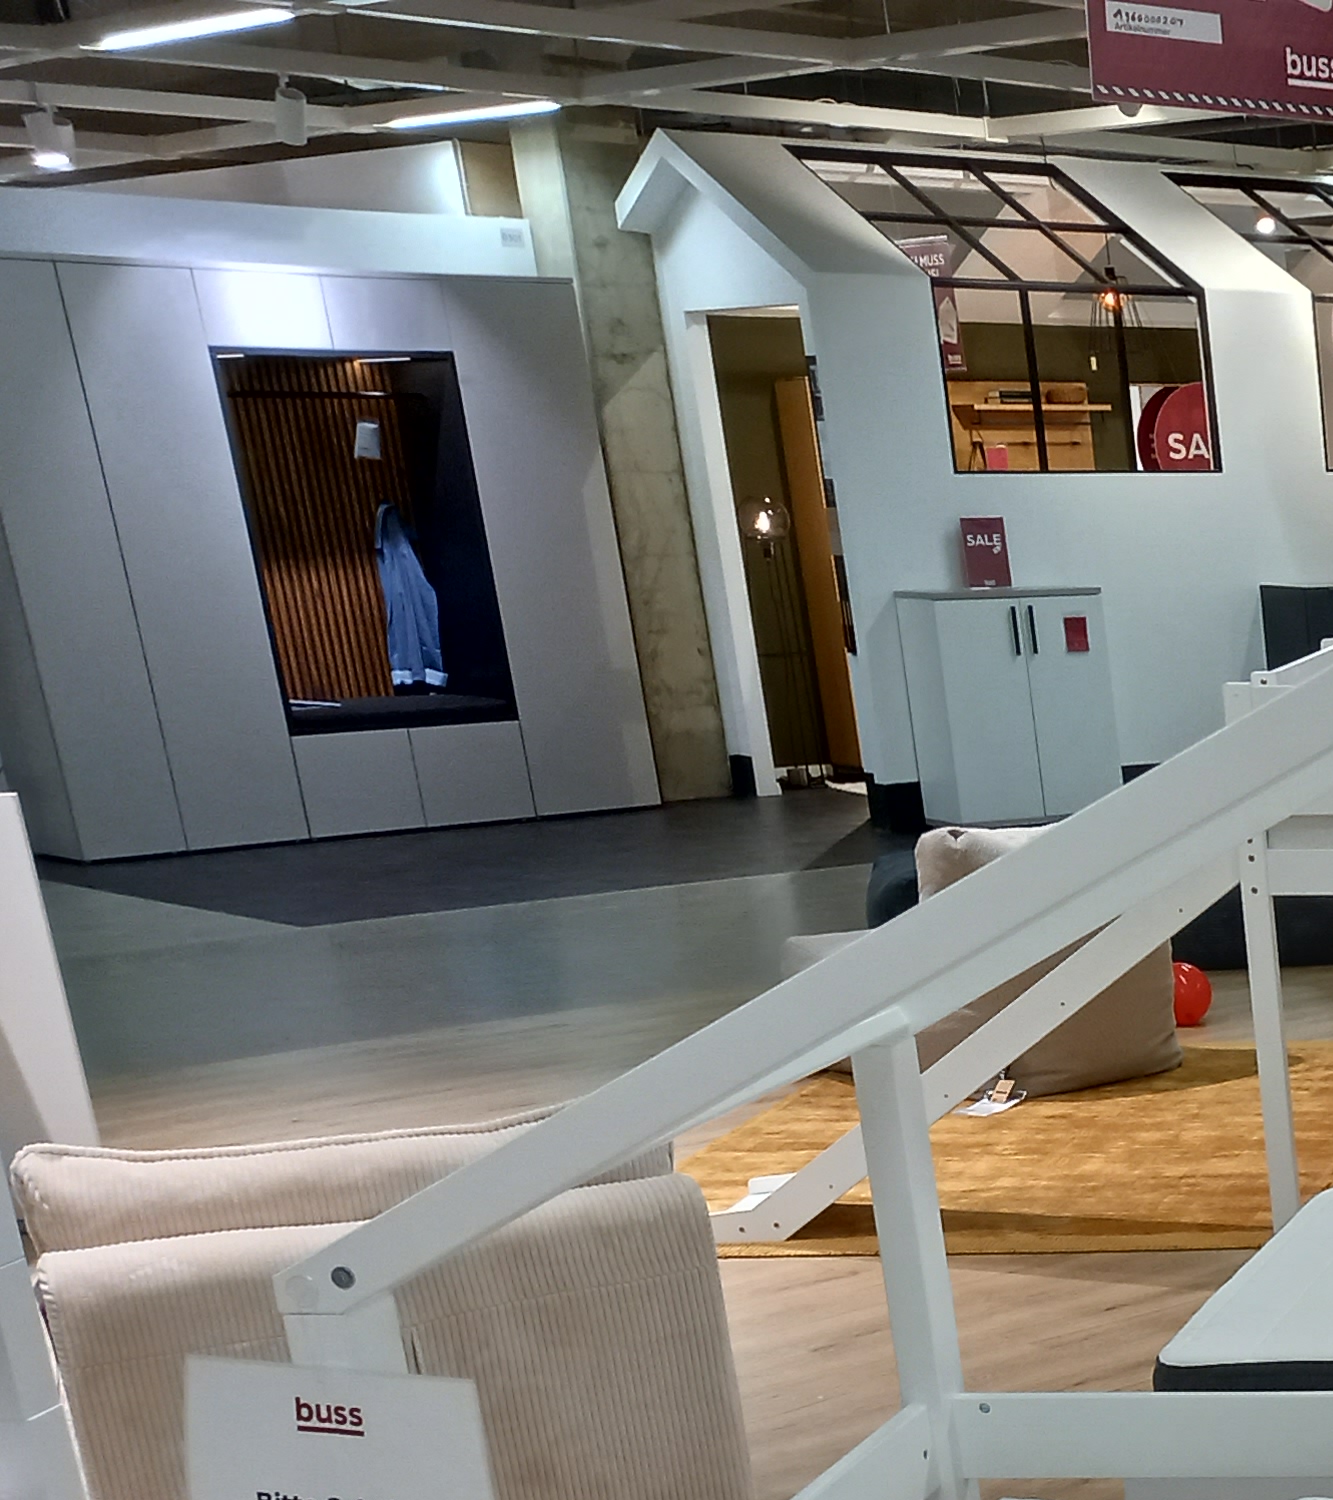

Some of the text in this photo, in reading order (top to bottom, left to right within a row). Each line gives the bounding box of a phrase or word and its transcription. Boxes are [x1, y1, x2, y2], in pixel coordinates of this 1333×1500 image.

[1168, 433, 1210, 460] SA
[966, 533, 1001, 546] SALE
[295, 1397, 363, 1427] buss
